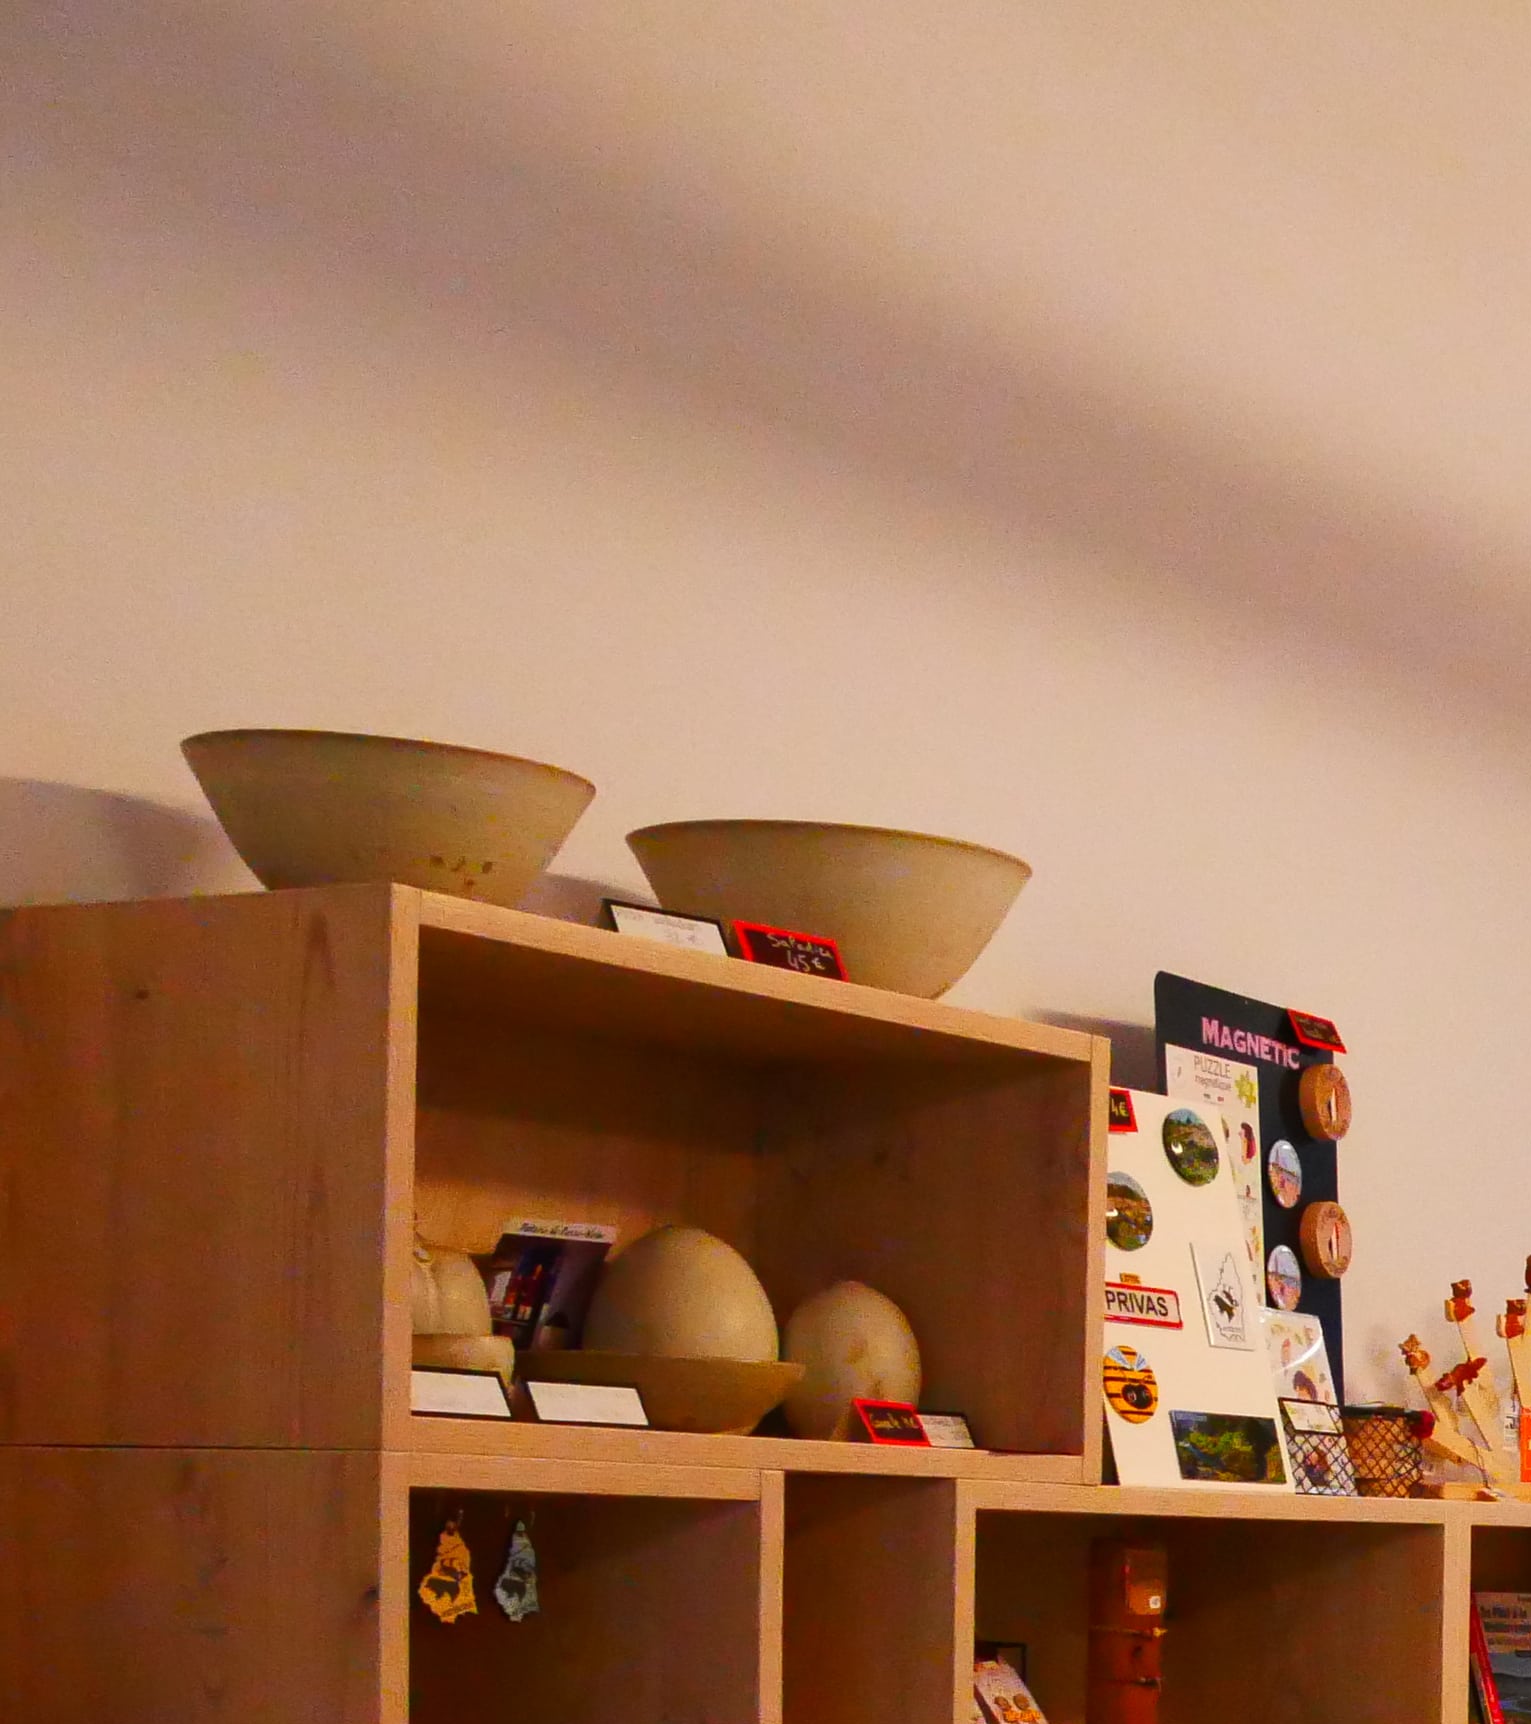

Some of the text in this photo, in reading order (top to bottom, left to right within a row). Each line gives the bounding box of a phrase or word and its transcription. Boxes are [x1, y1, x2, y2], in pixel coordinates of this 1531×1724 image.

[1201, 1017, 1300, 1070] MAGNETIC
[1194, 1055, 1231, 1079] PUZZLE
[1104, 1290, 1170, 1317] PRIVAS
